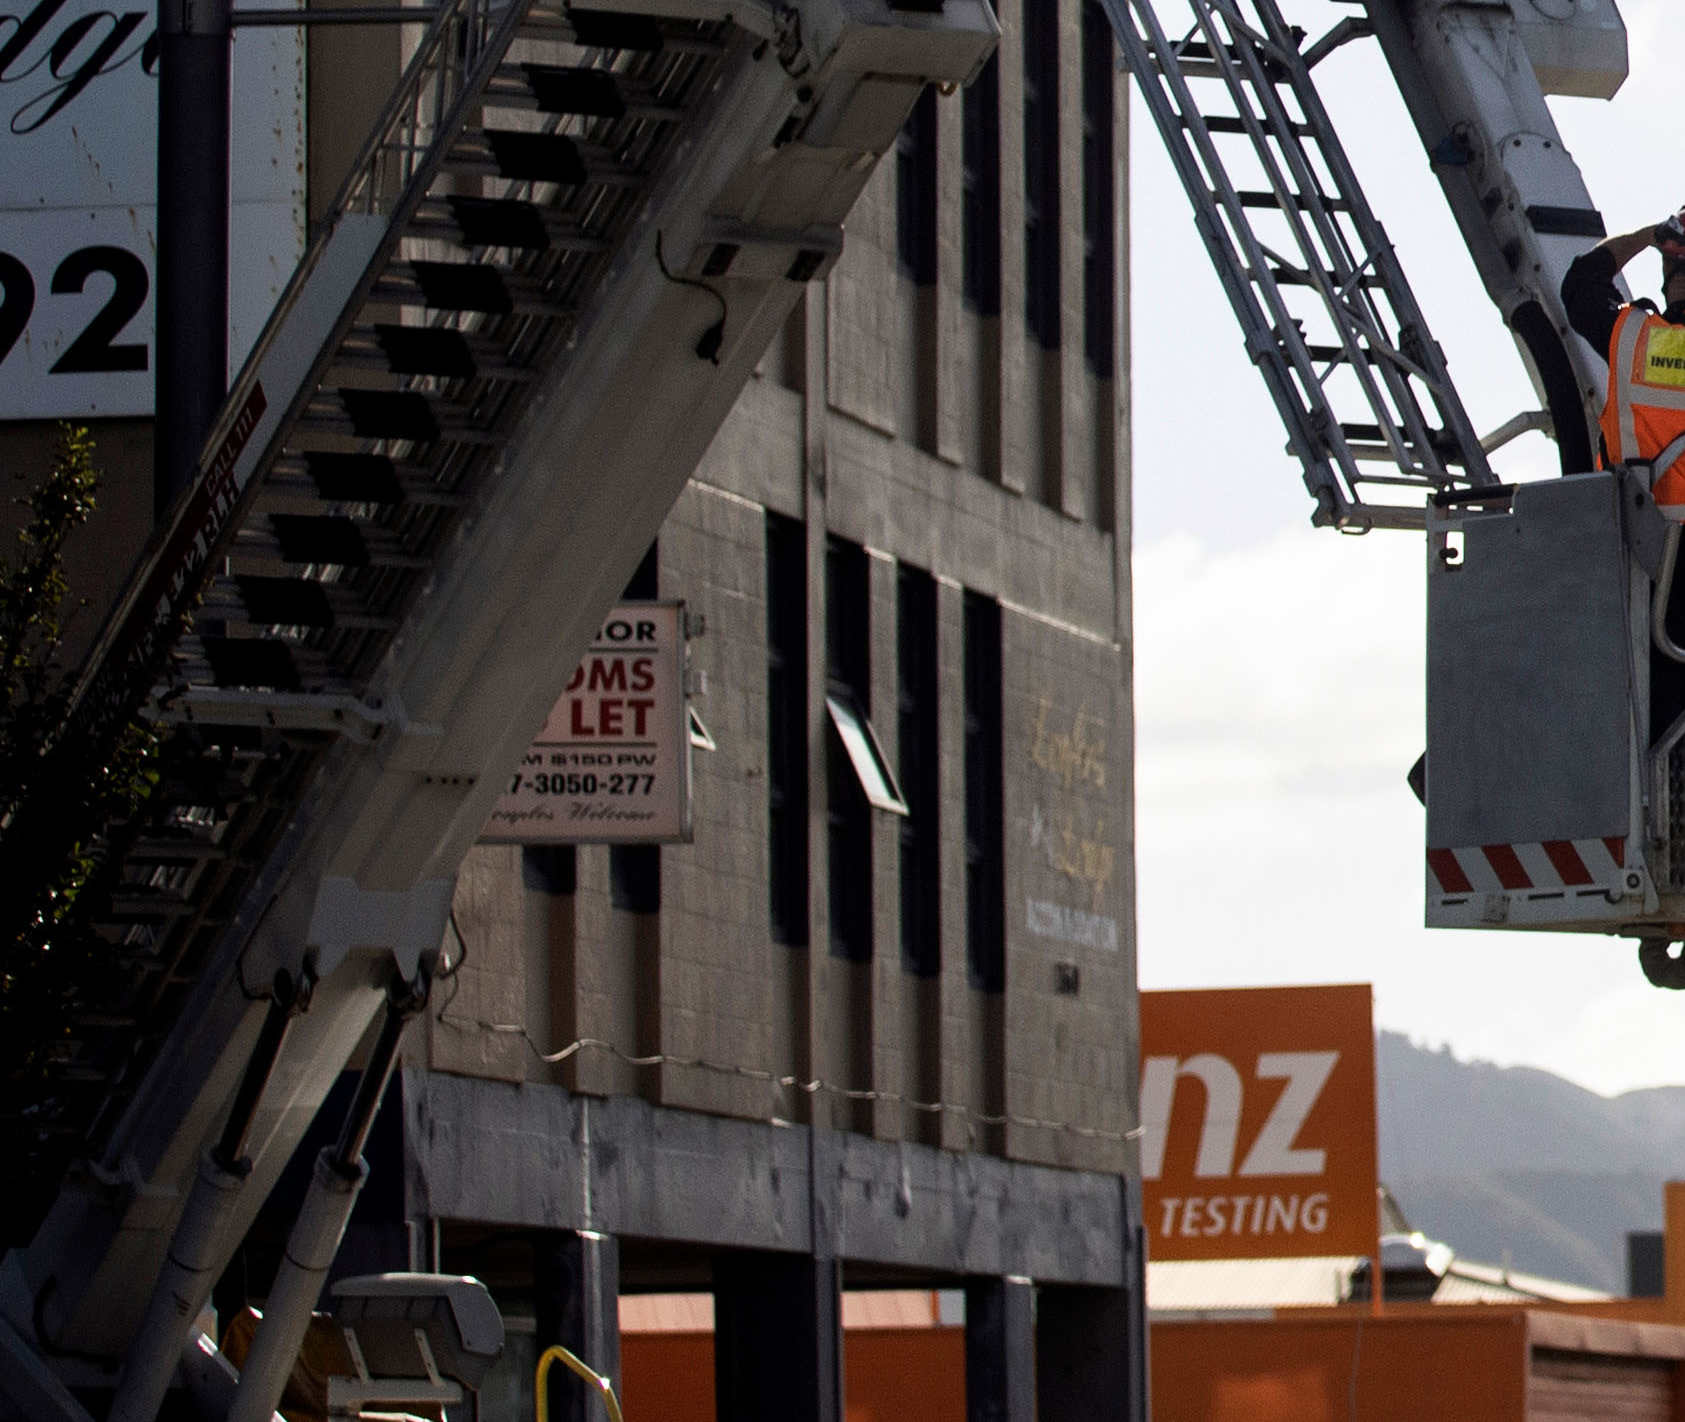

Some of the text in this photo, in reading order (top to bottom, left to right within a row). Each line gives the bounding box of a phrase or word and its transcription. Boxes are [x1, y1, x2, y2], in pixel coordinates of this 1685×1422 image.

[205, 407, 254, 498] CALL 111
[596, 620, 656, 642] OR
[571, 699, 655, 737] LET
[1160, 1193, 1329, 1239] TESTING
